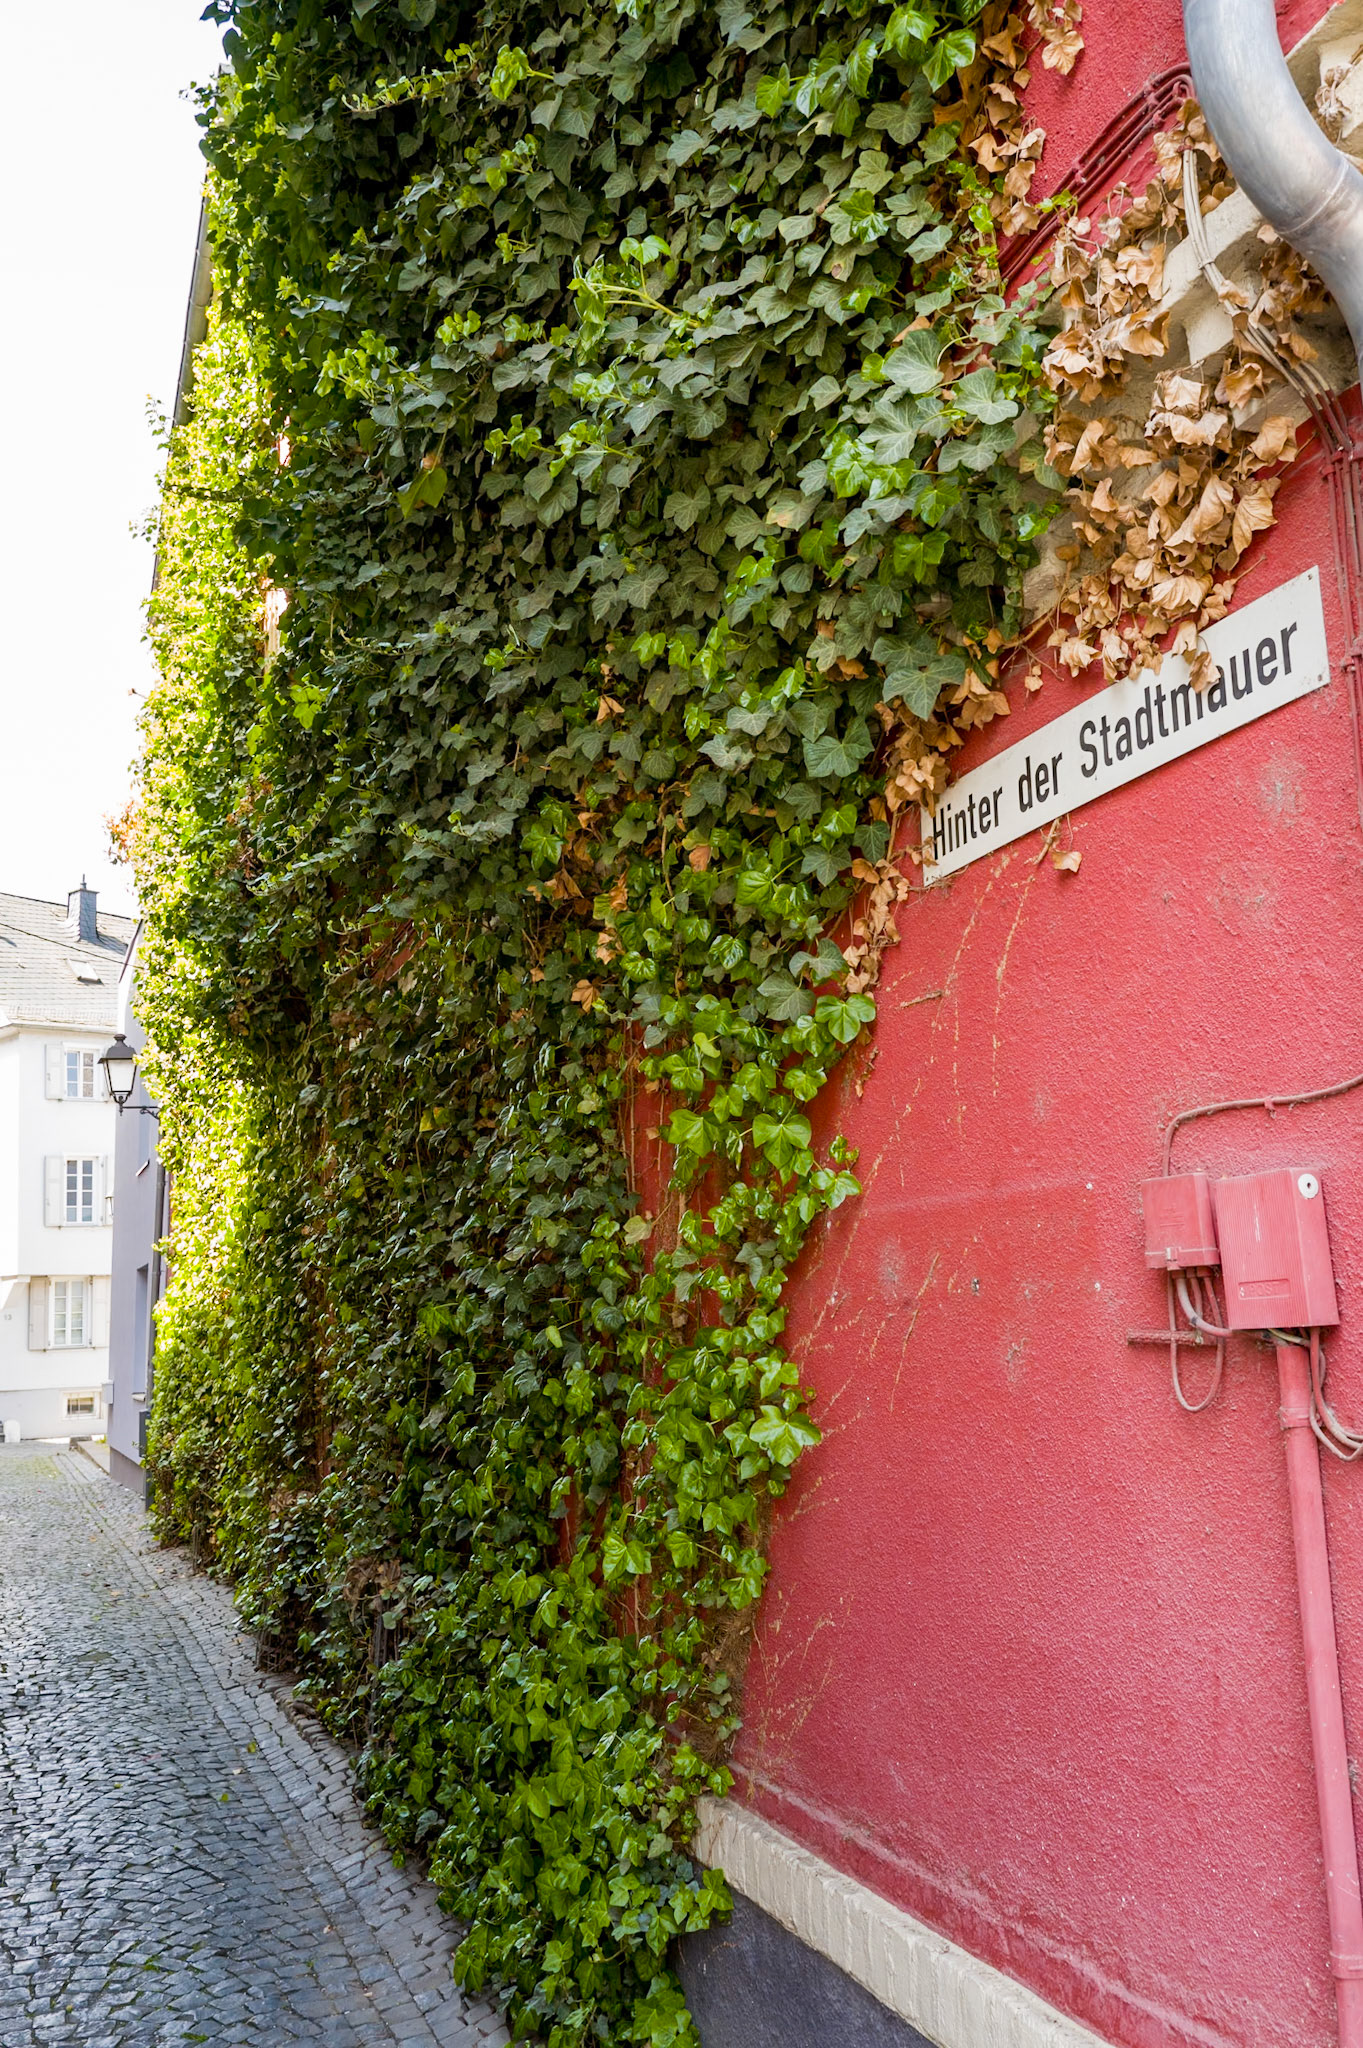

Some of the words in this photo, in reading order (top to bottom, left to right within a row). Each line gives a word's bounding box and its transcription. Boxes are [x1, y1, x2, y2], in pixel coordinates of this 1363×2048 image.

[933, 786, 1003, 861] Hinter
[1018, 752, 1063, 813] der
[1079, 621, 1298, 779] Stadtmauer
